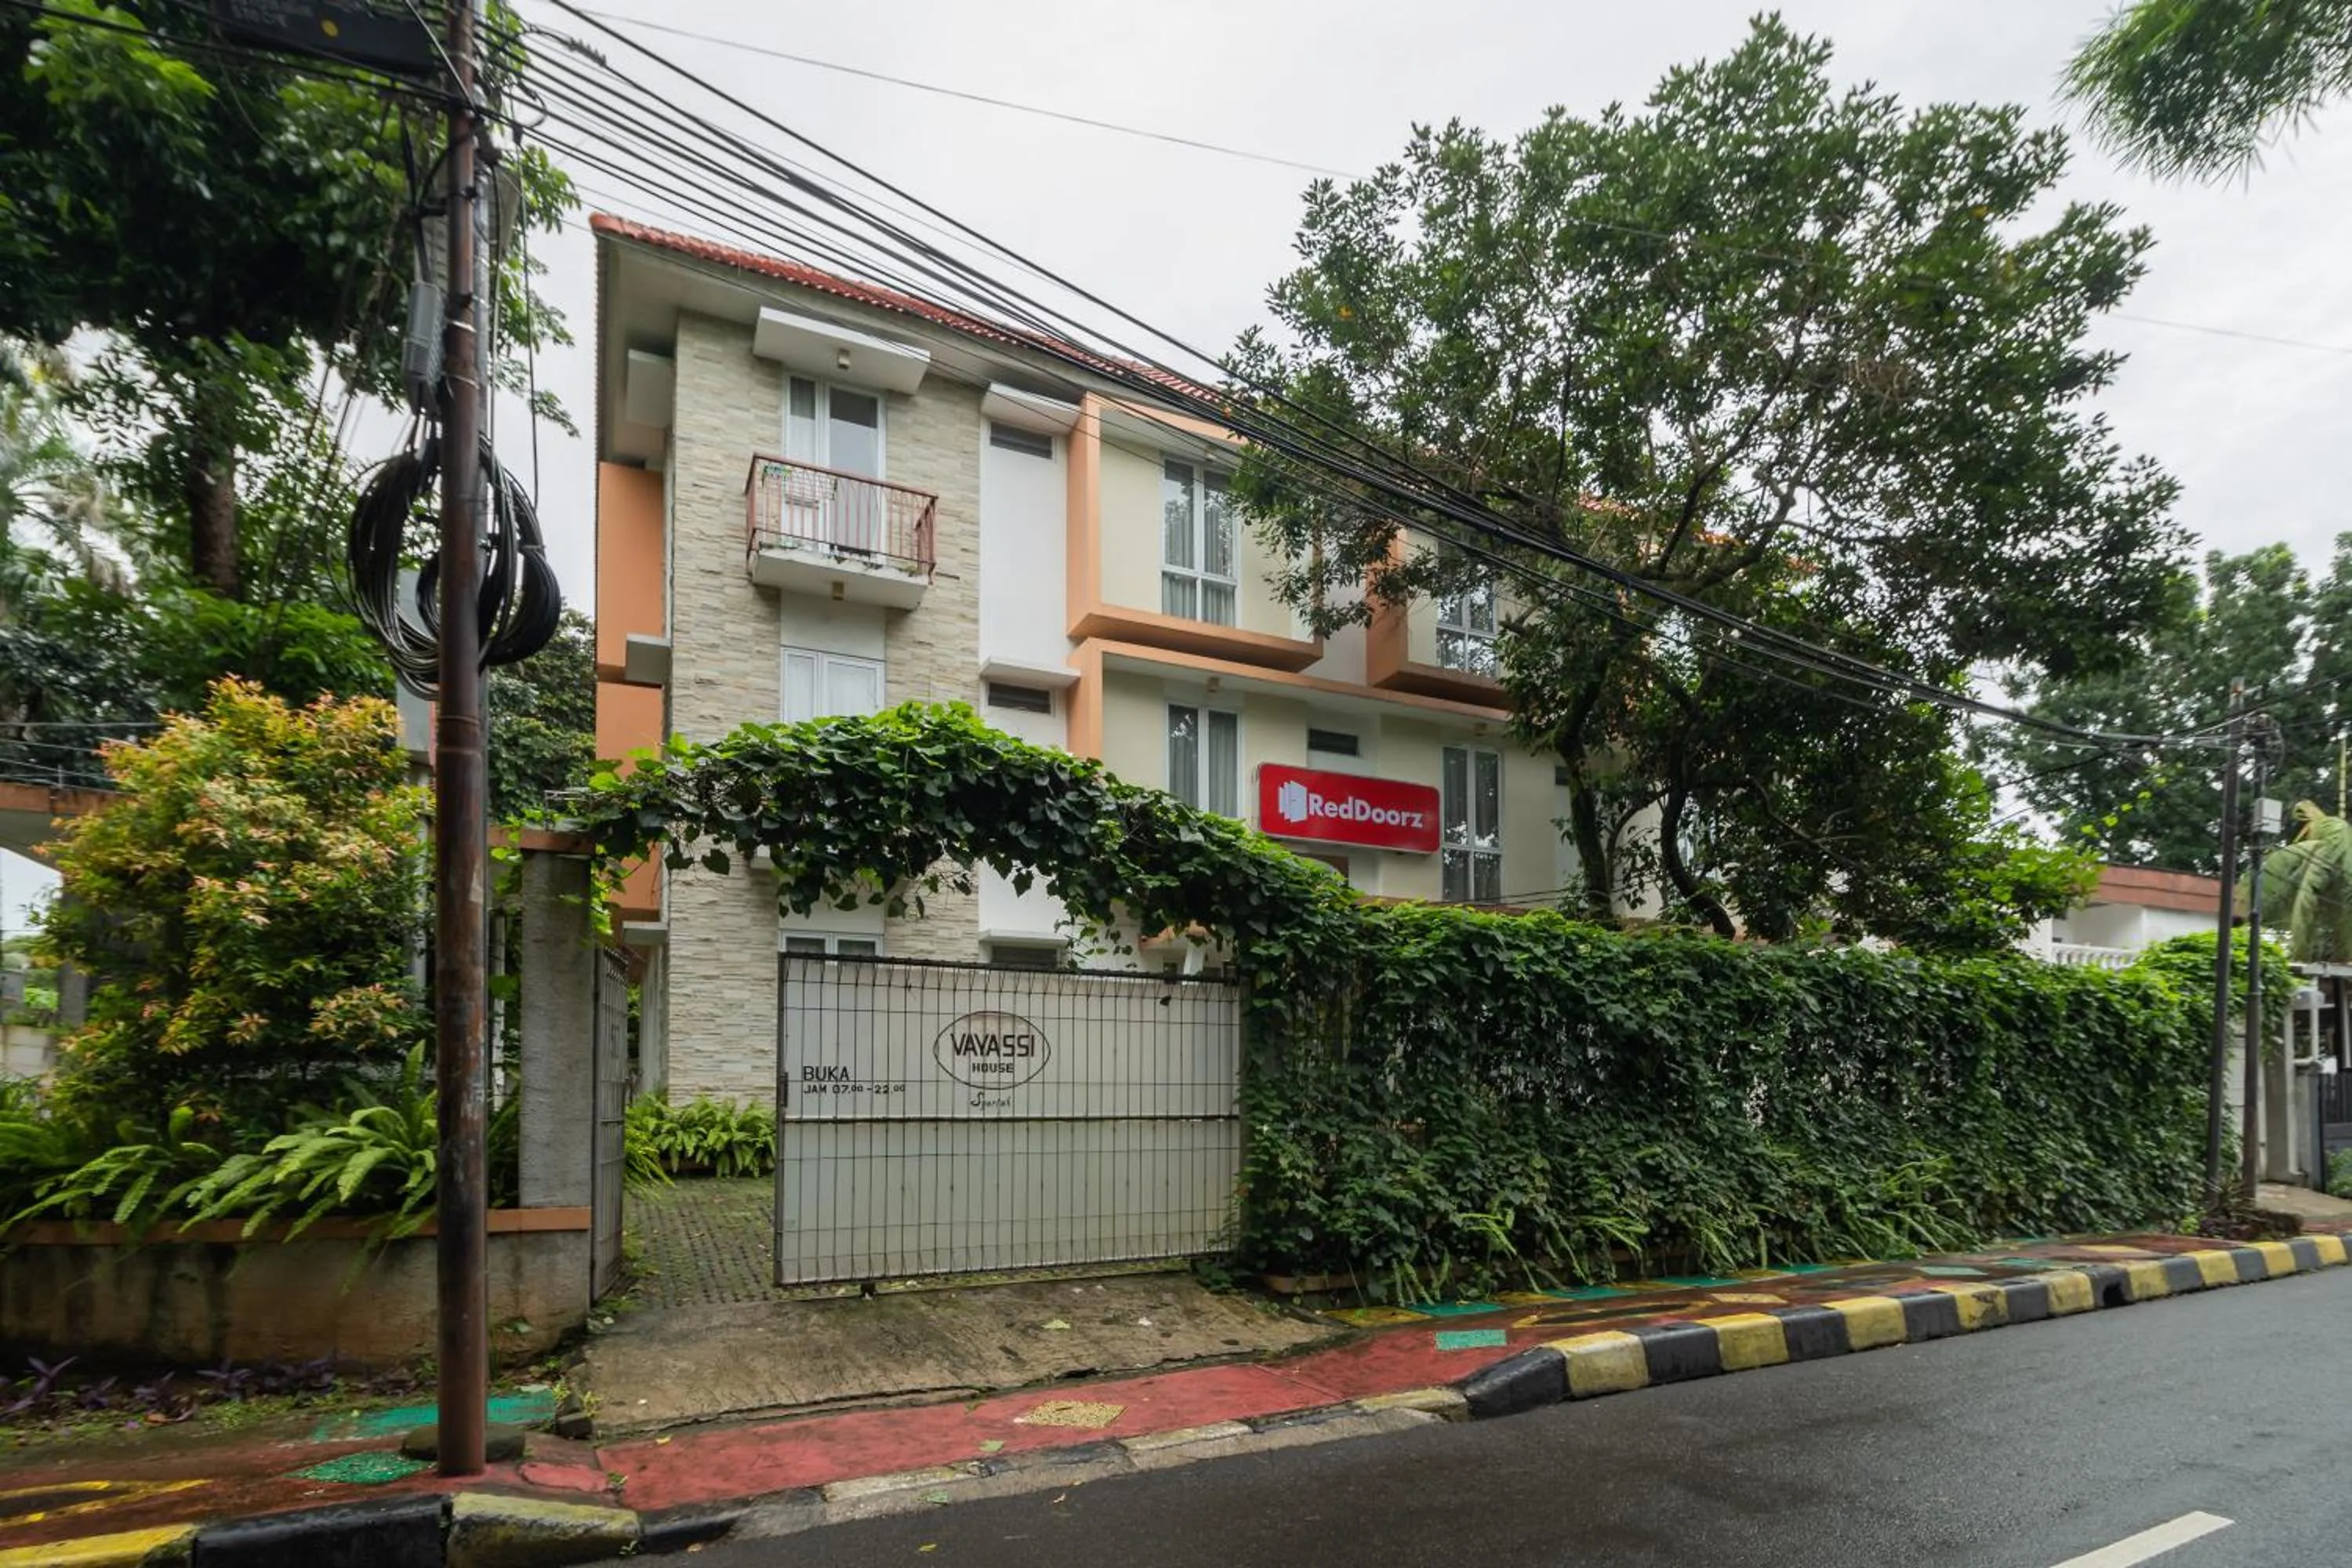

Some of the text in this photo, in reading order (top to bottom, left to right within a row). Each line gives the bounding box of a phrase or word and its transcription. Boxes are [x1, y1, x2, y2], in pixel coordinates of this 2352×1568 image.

[1308, 793, 1423, 829] RedDoorz
[950, 1033, 1035, 1057] VAYASSI
[803, 1065, 850, 1082] BUKA
[972, 1062, 1014, 1073] HOUSE
[804, 1084, 827, 1094] JAM
[833, 1084, 863, 1094] 07.00
